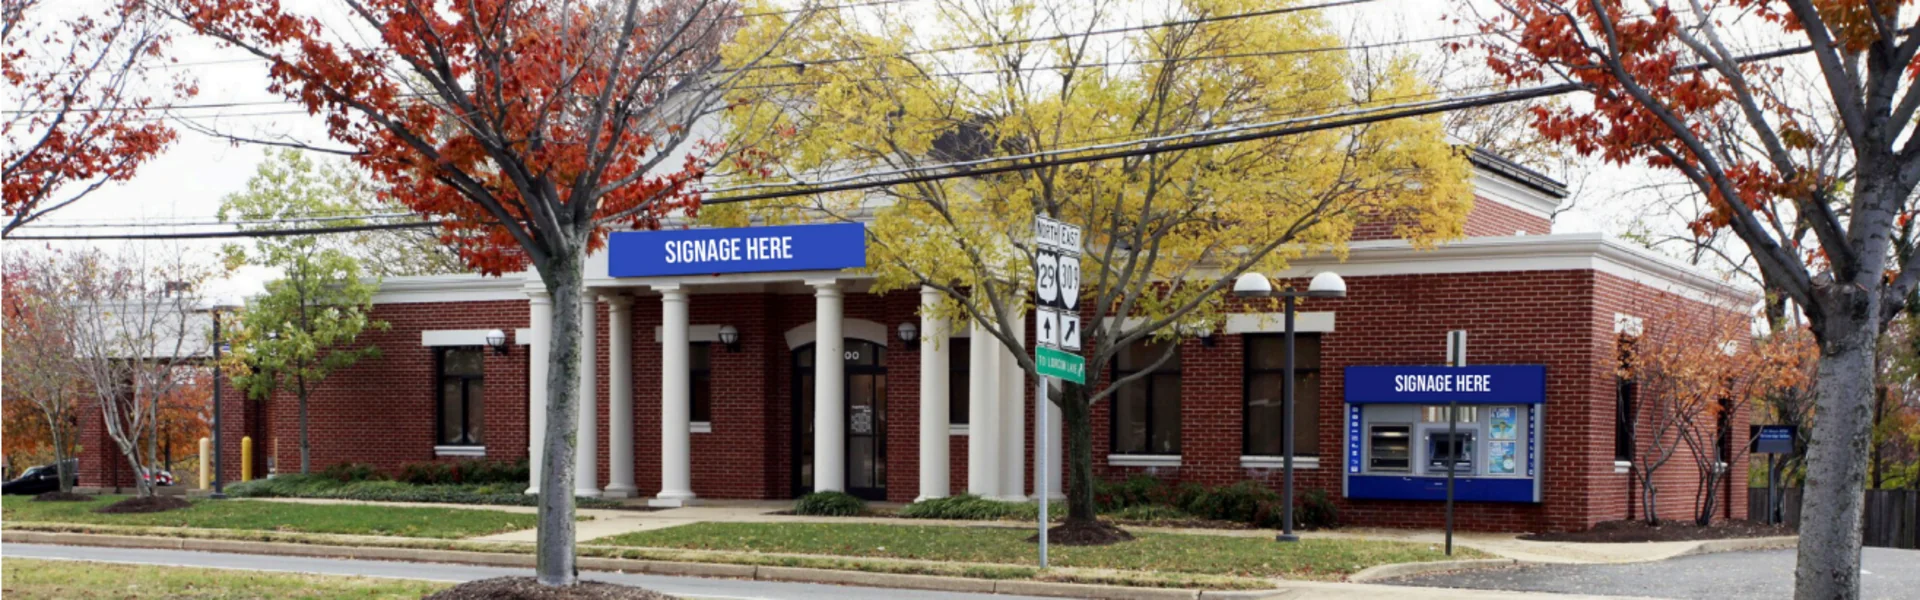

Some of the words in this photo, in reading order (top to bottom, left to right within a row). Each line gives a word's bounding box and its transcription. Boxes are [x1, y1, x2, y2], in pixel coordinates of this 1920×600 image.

[1037, 220, 1058, 241] NORTH
[1062, 226, 1079, 247] EAST
[665, 238, 741, 264] SIGNAGE
[746, 236, 793, 260] HERE
[1040, 263, 1055, 289] 29
[1062, 263, 1078, 290] 309
[1395, 374, 1453, 392] SIGNAGE
[1456, 374, 1491, 392] HERE
